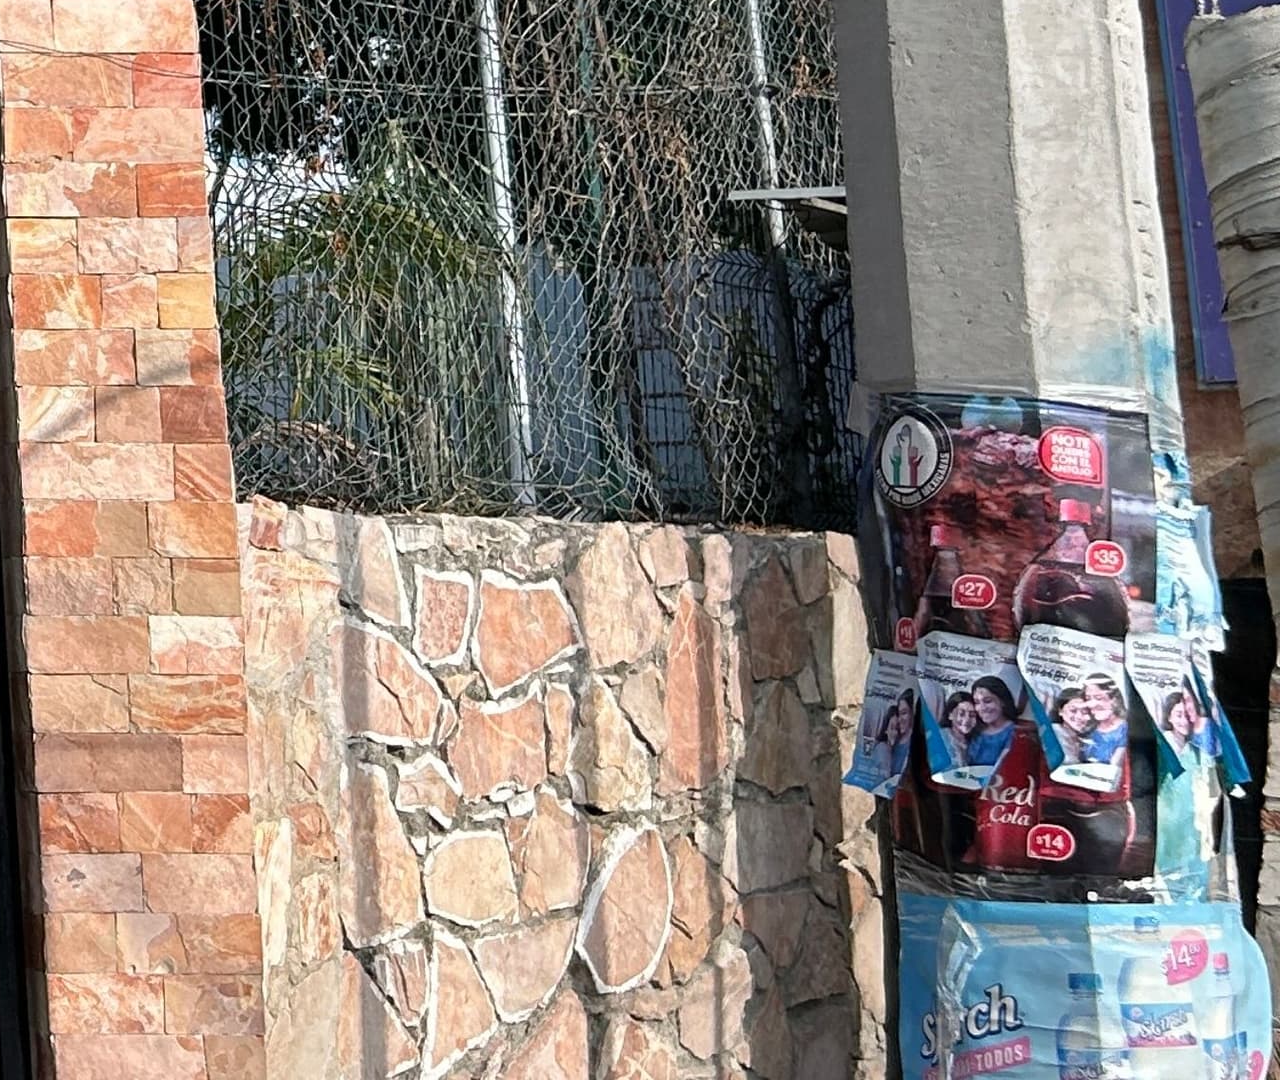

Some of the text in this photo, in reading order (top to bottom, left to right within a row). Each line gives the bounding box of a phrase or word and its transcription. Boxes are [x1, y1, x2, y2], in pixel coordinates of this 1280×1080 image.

[1094, 549, 1120, 565] $35
[959, 581, 986, 597] $27
[978, 775, 1036, 808] Red
[990, 804, 1031, 827] Cola
[1035, 833, 1065, 850] $14
